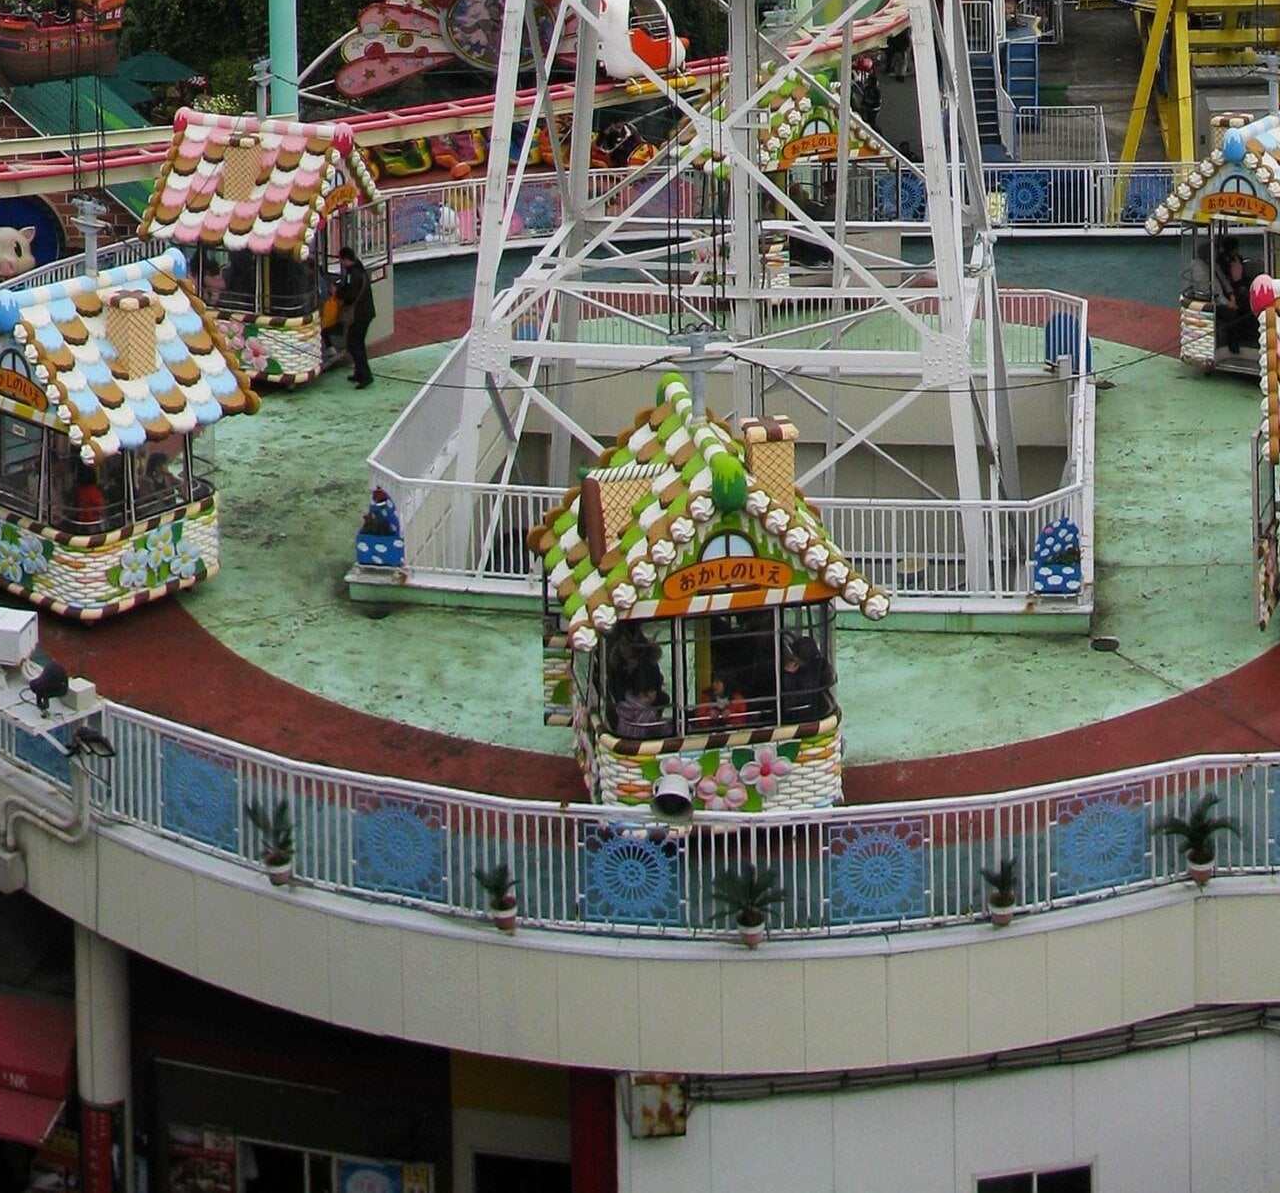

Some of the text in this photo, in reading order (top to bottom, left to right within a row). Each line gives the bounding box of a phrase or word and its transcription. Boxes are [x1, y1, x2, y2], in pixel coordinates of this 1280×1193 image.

[791, 137, 839, 155] おかしのい
[1208, 197, 1268, 217] おかしのいえ
[680, 563, 781, 591] おかしのいえ
